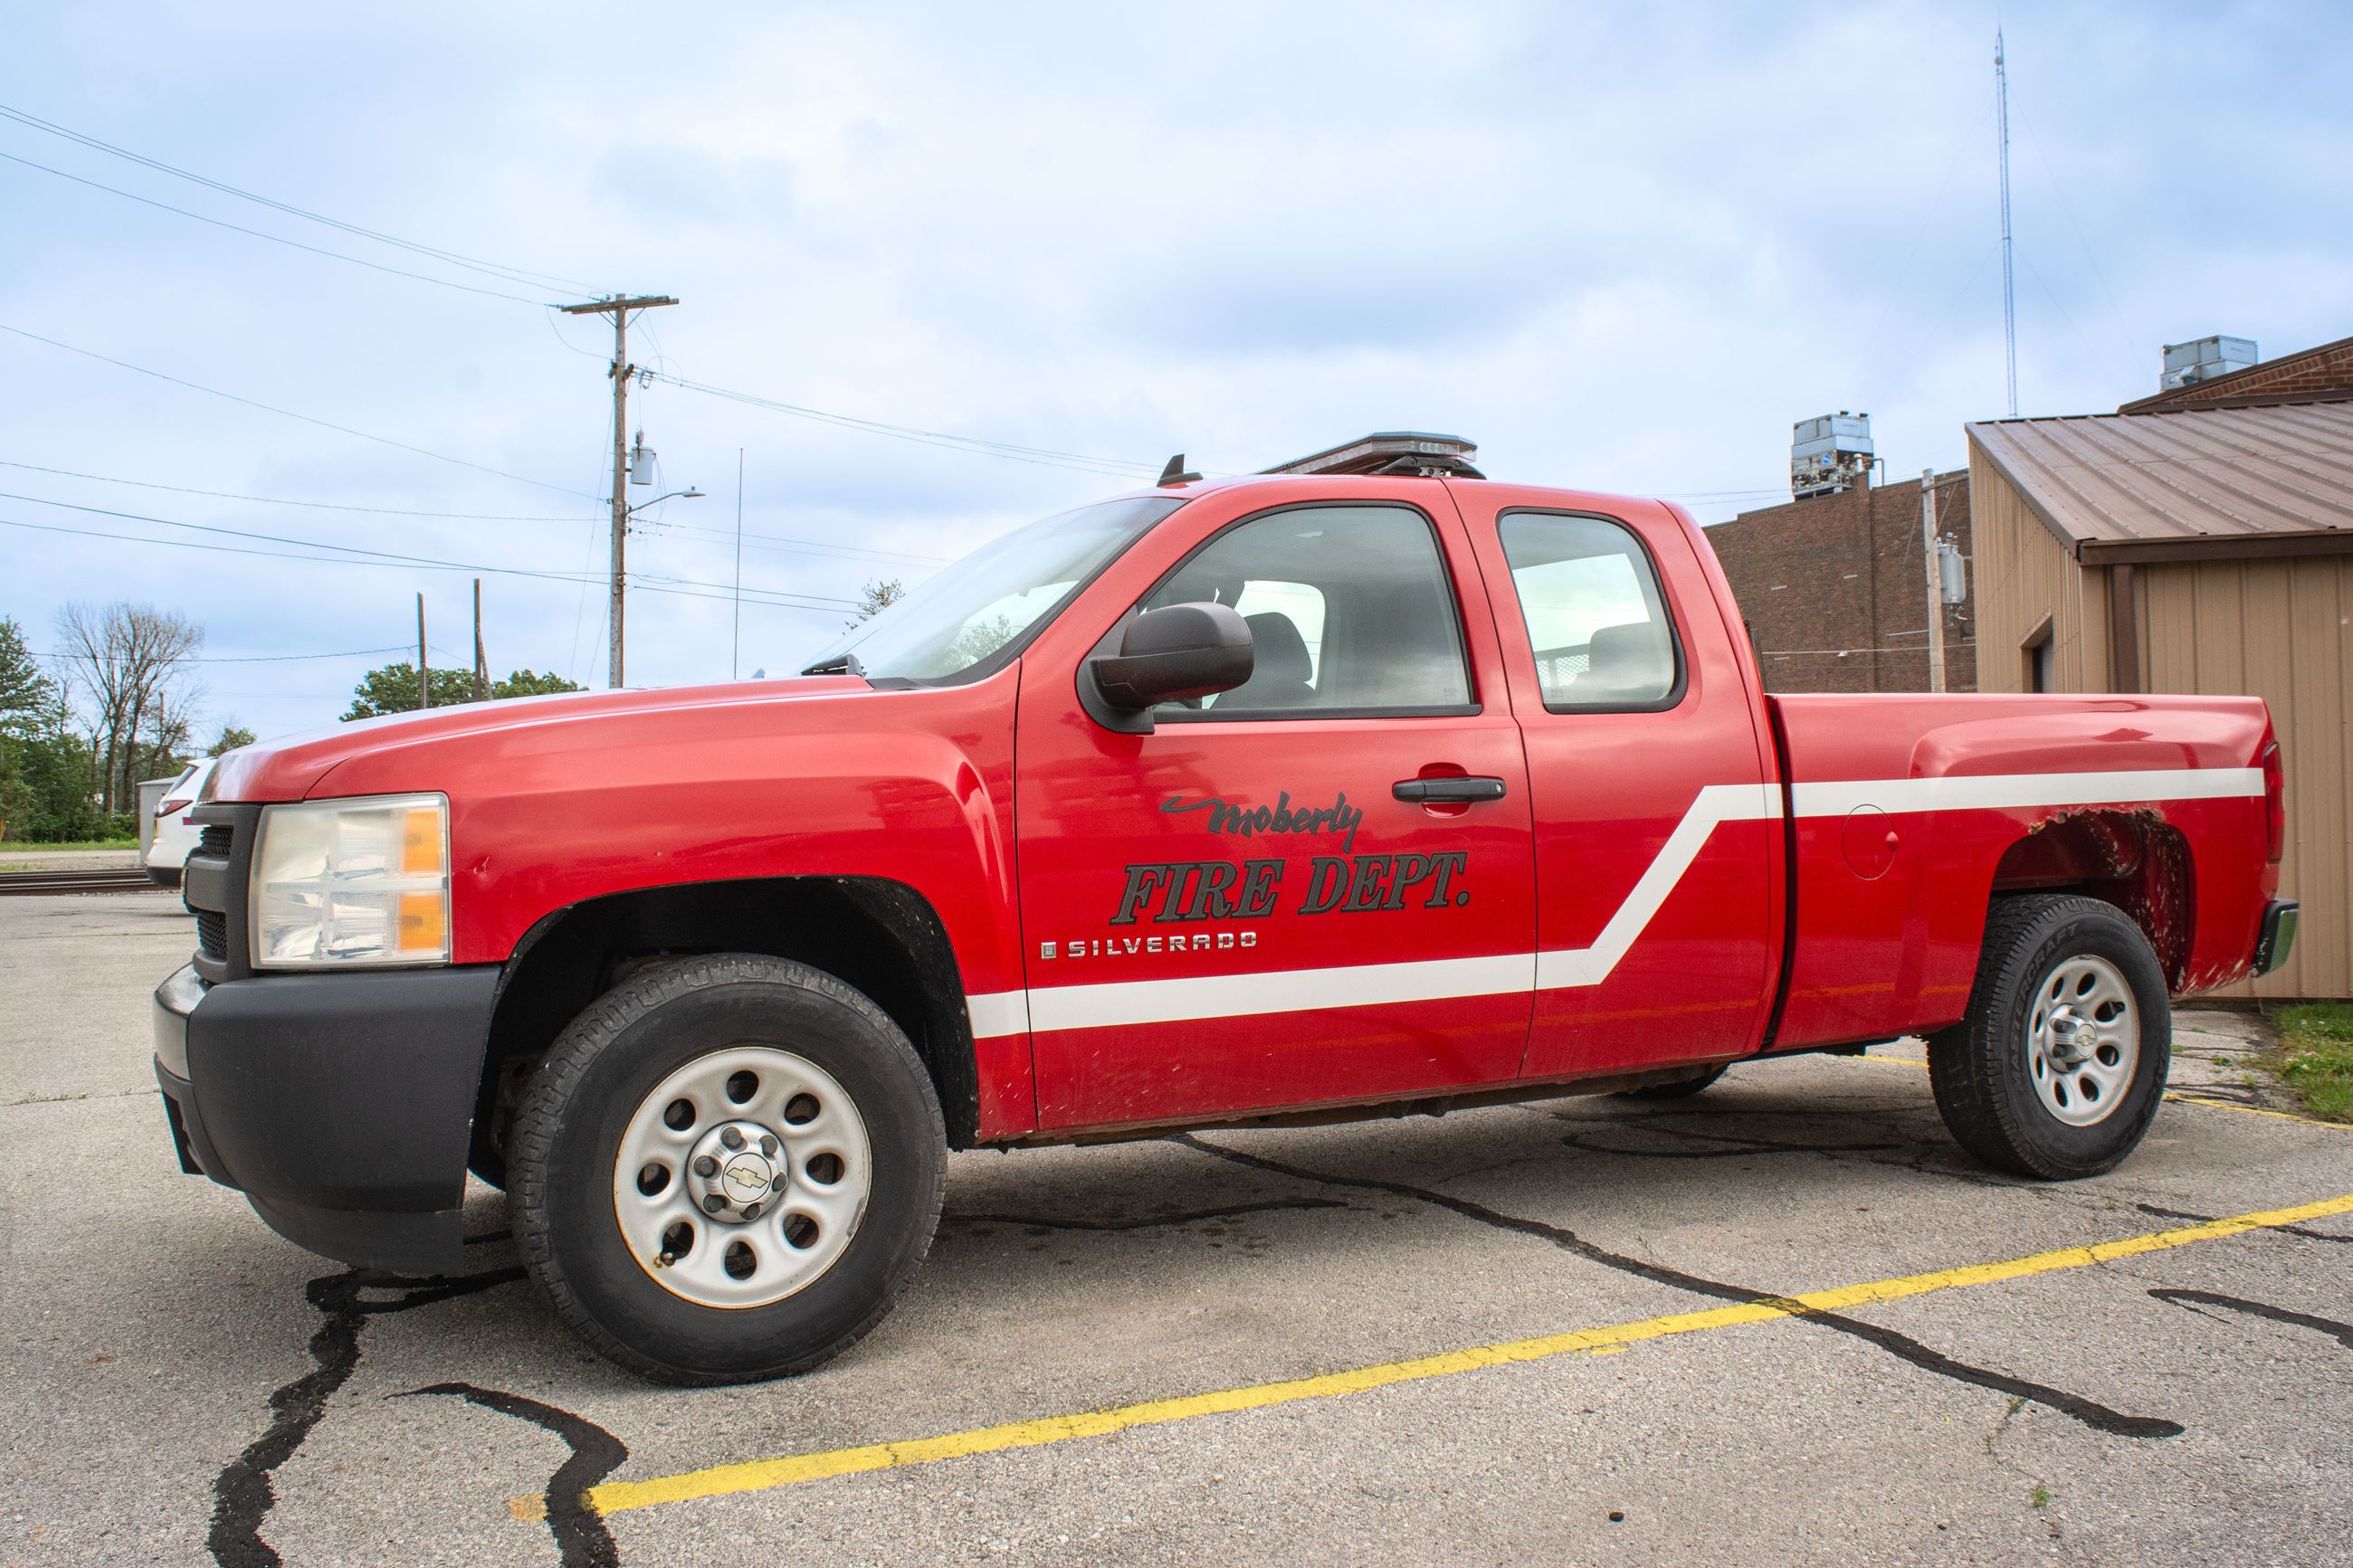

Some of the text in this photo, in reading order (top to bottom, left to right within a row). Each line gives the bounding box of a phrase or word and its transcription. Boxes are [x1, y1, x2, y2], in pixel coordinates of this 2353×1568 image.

[1110, 851, 1470, 925] FIRE DEPT.
[1068, 931, 1257, 958] SILVERADO
